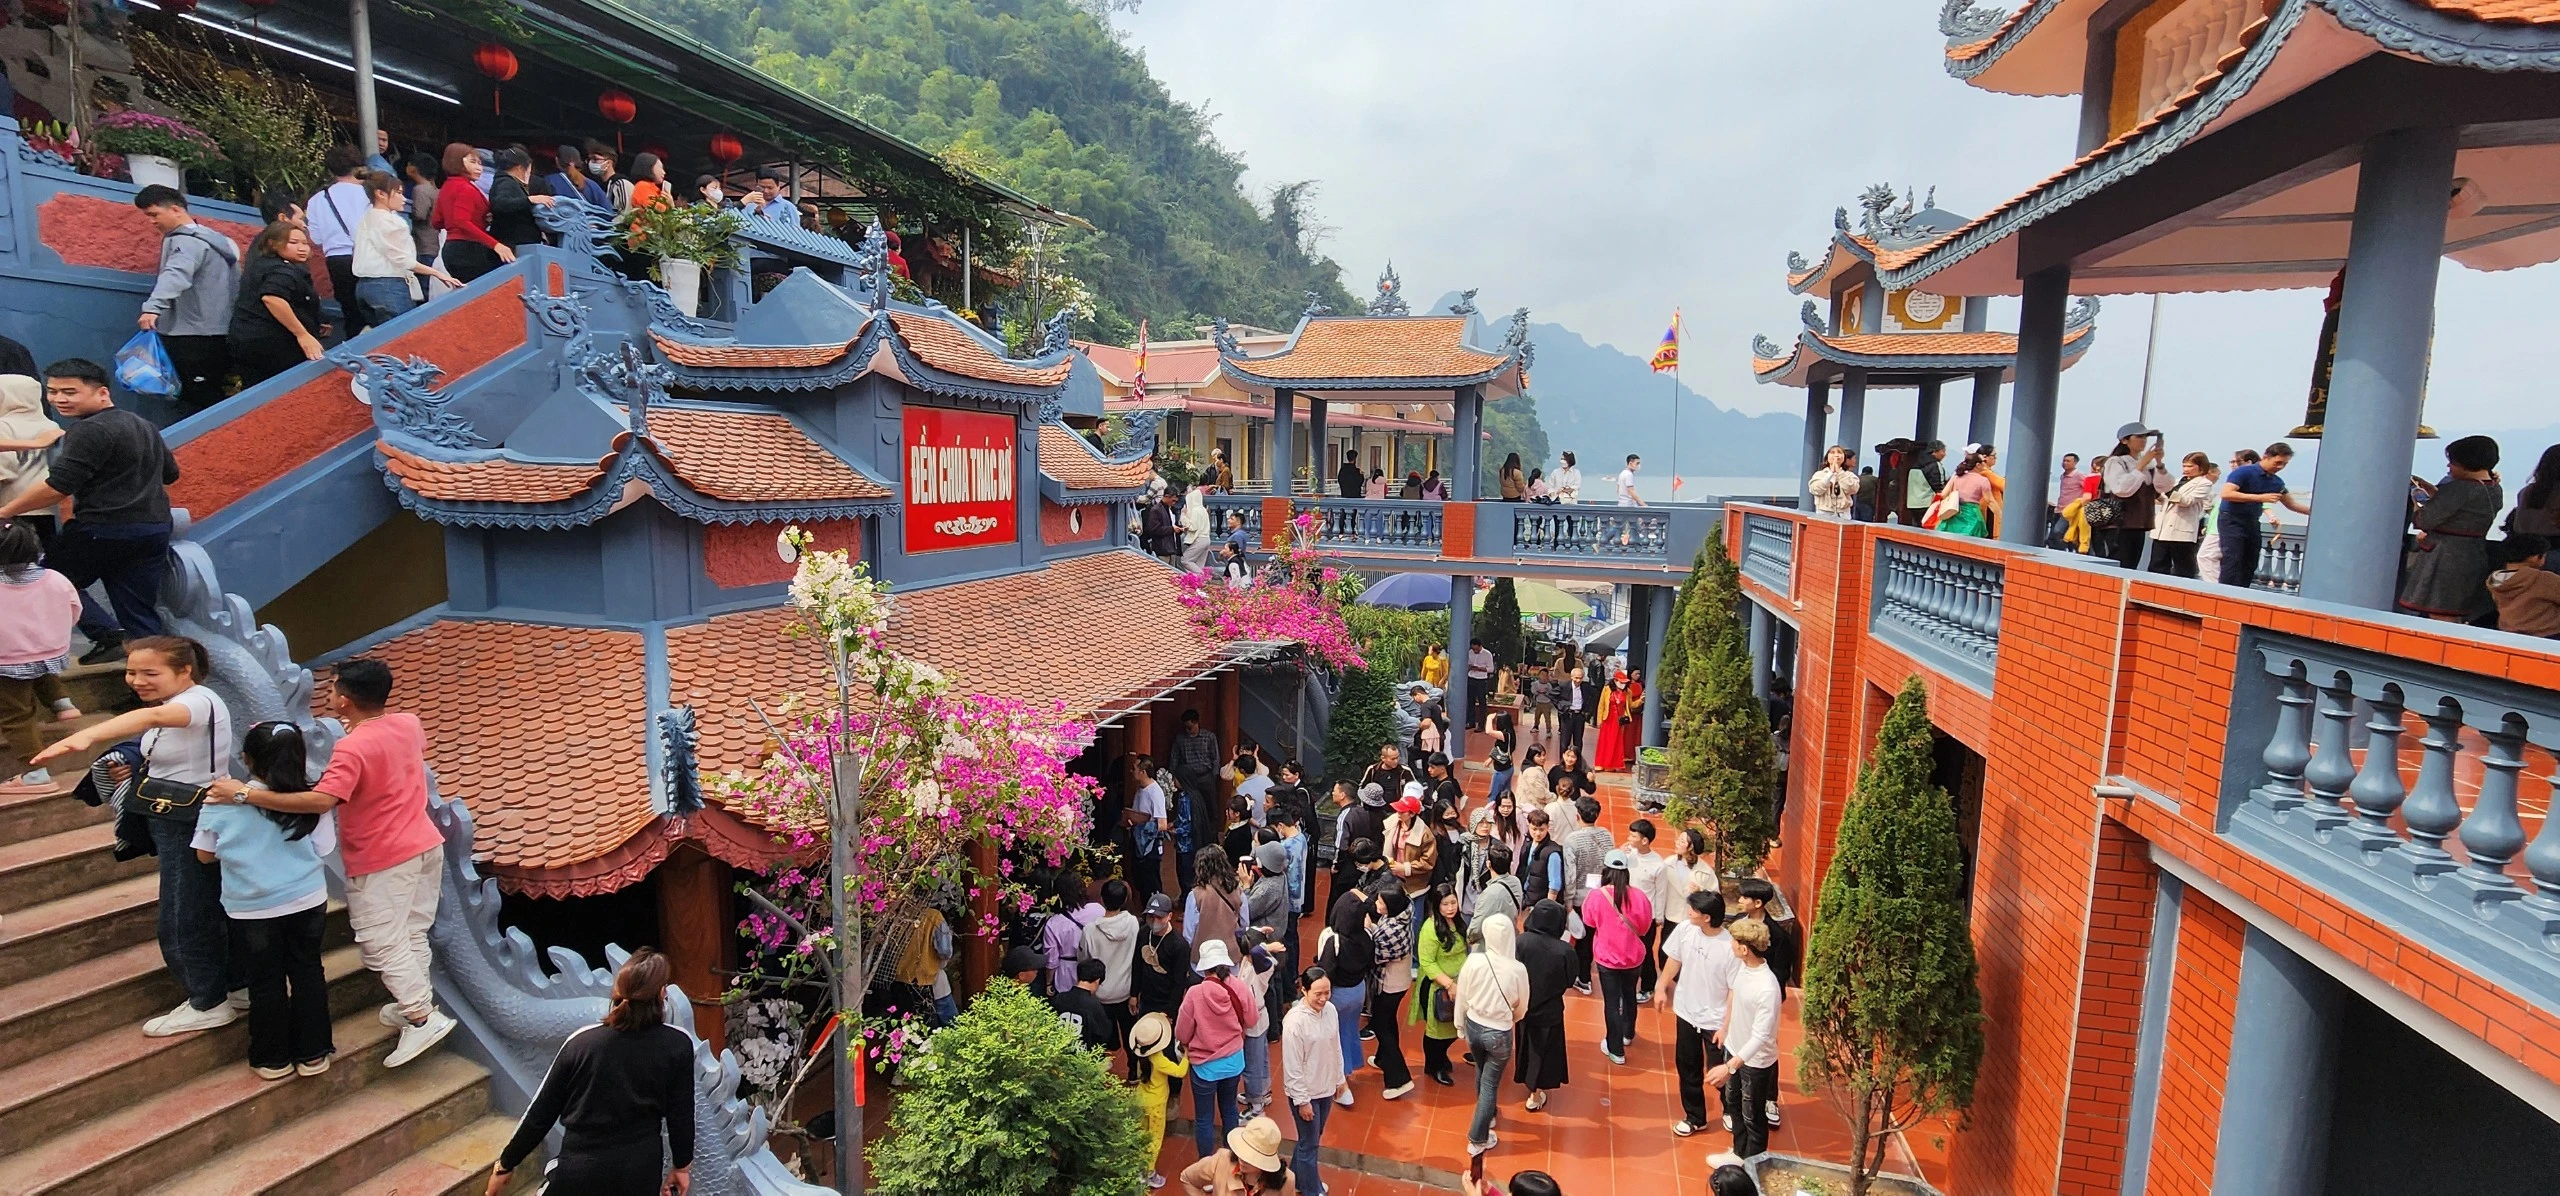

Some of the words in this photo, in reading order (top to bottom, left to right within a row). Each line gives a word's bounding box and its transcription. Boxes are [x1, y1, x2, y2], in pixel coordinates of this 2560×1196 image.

[911, 425, 938, 504] ĐỀN
[939, 435, 970, 504] CHÚA
[970, 436, 997, 502] THÁC
[998, 436, 1012, 501] BỜ
